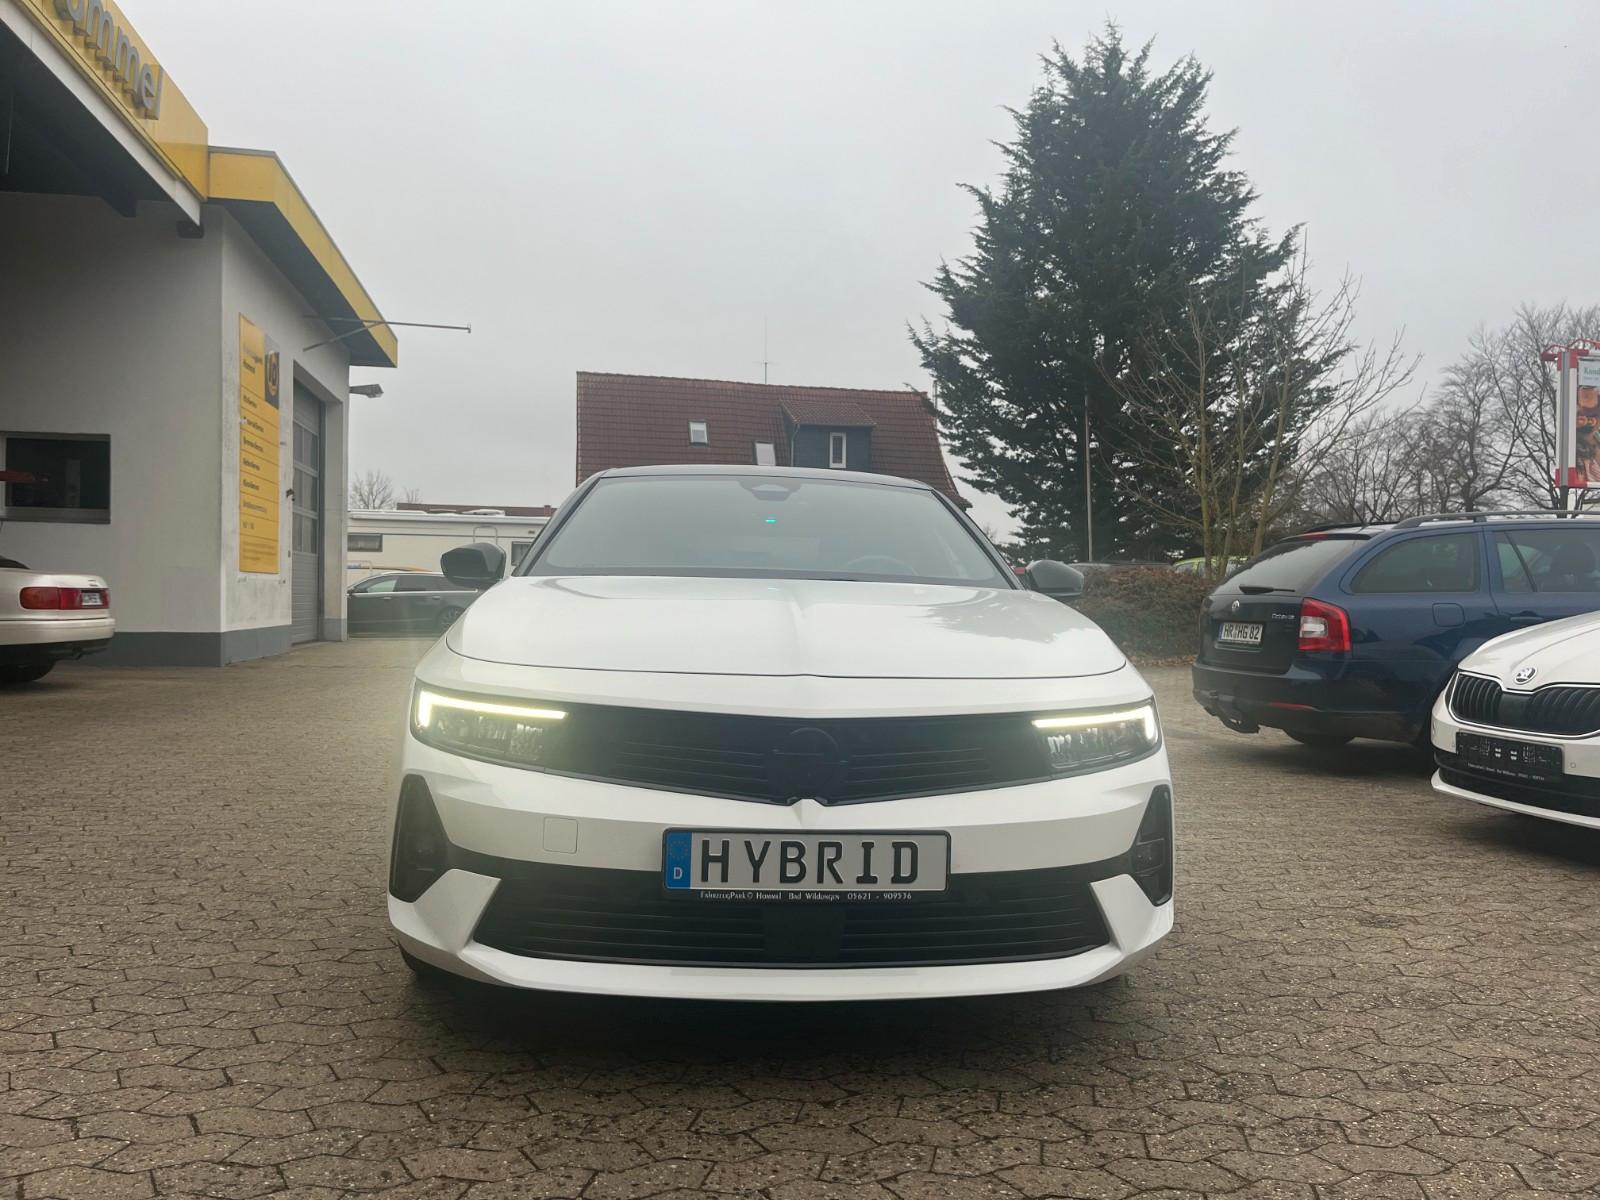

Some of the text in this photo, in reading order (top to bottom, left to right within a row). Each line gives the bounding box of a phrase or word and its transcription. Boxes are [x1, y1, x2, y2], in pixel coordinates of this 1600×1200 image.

[700, 839, 919, 884] HYBRID
[673, 867, 682, 879] D
[788, 892, 802, 900] Bad
[847, 892, 871, 900] 05621
